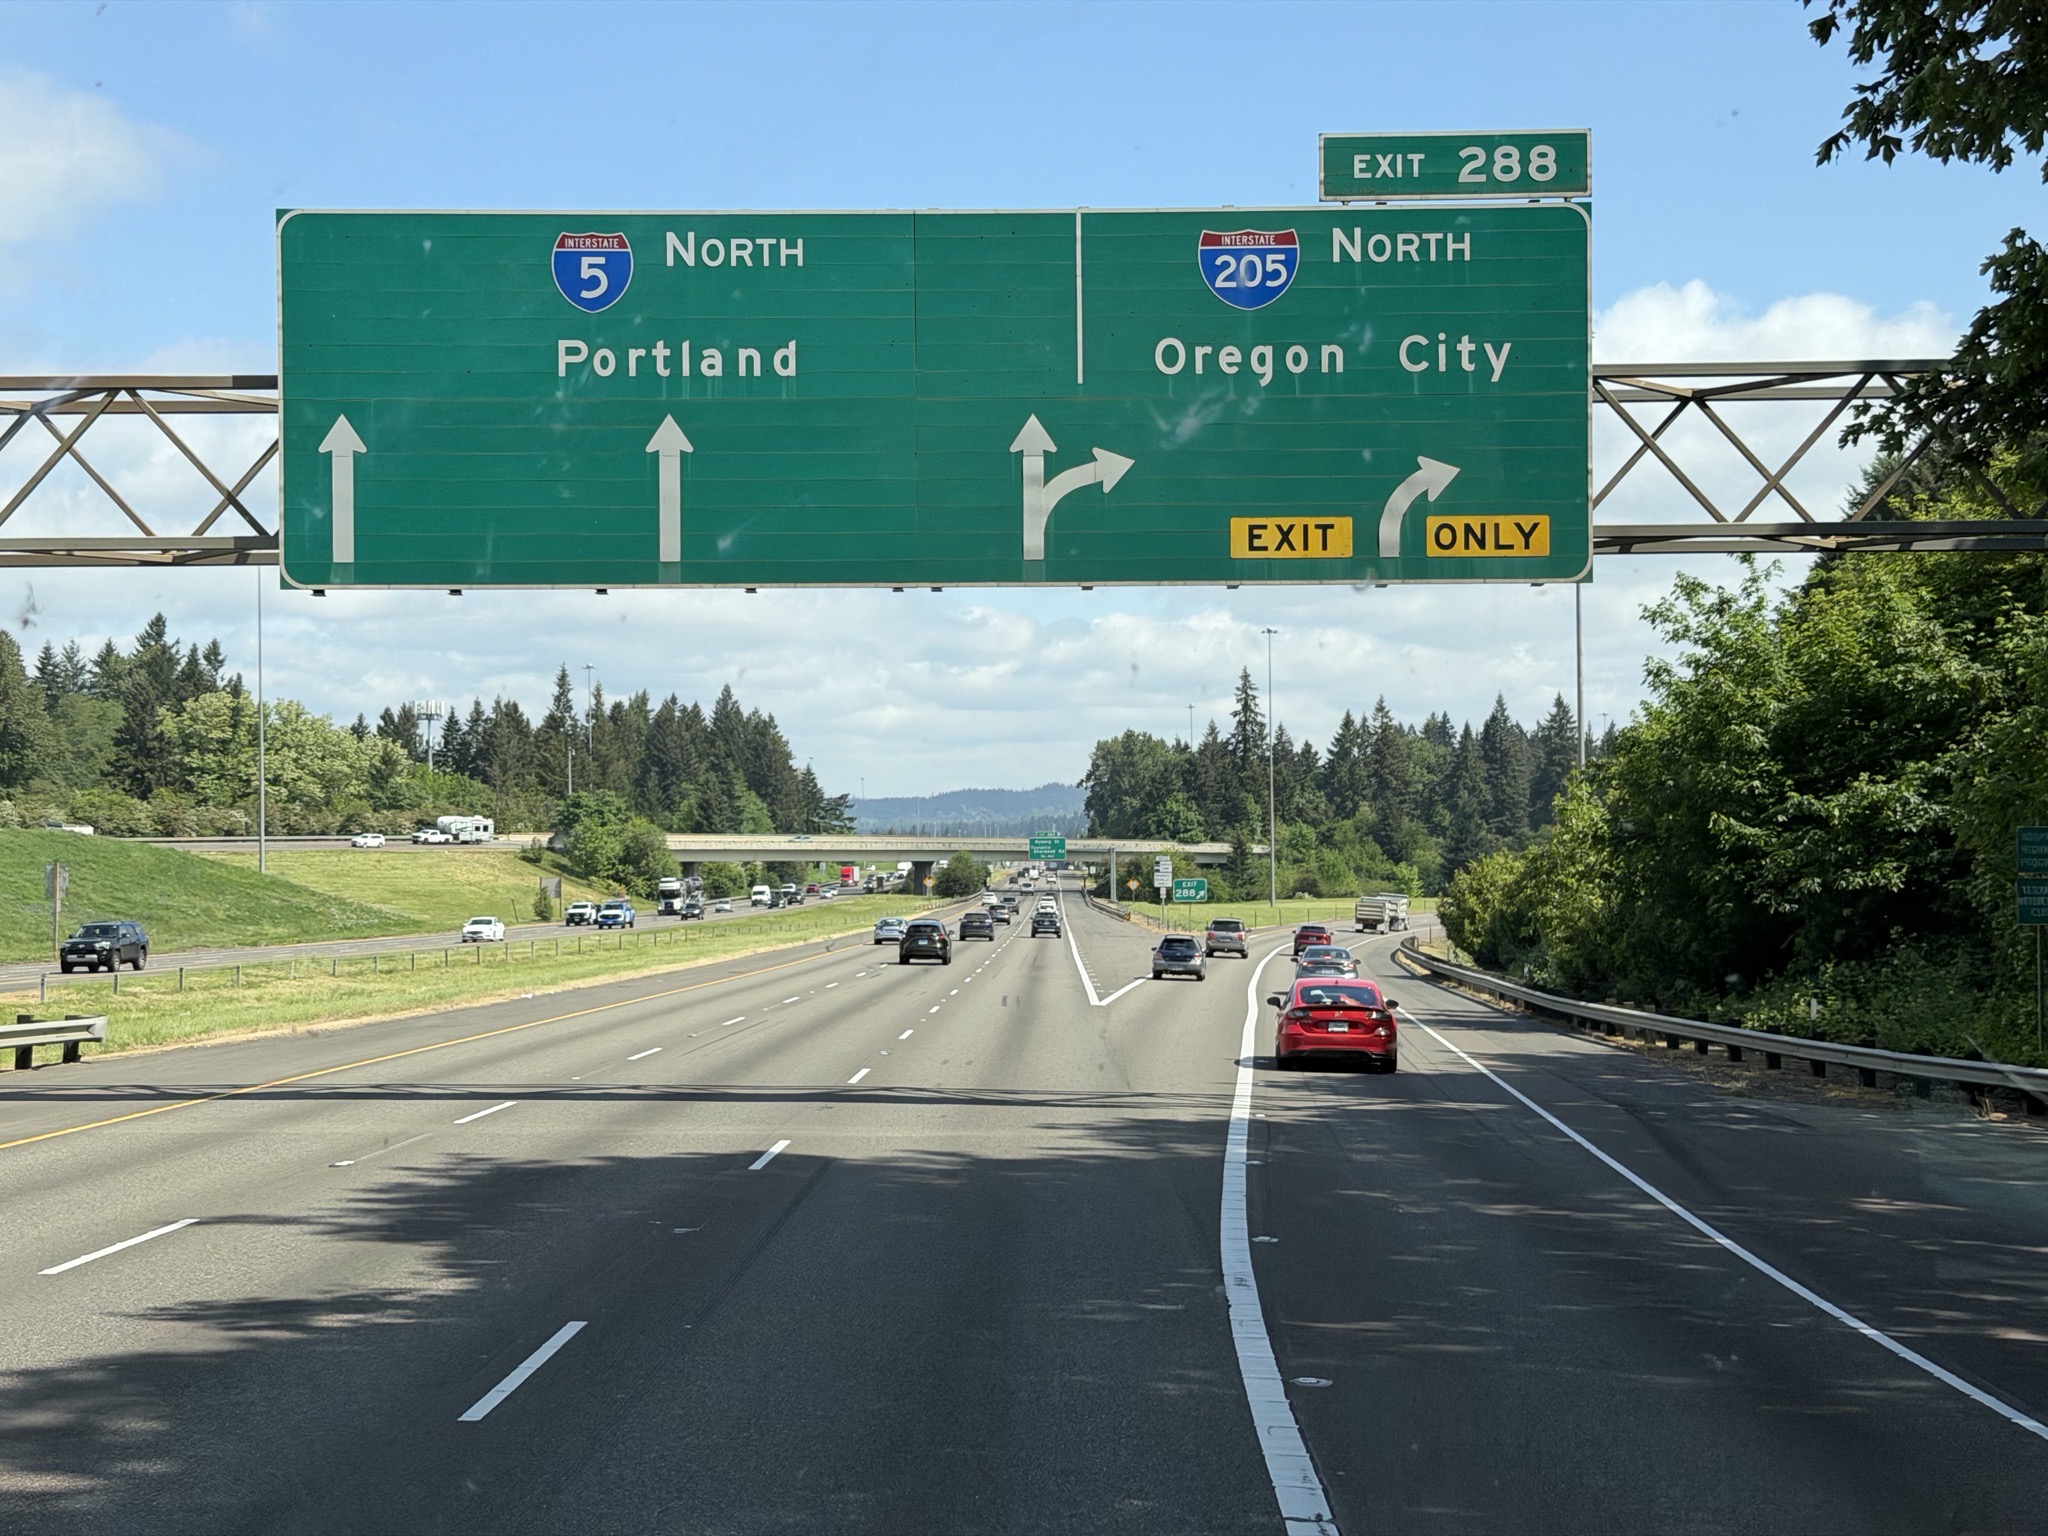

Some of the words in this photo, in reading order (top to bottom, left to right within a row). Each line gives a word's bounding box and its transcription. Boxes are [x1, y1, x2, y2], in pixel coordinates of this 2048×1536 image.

[1353, 153, 1425, 180] EXIT
[1458, 144, 1558, 183] 288
[564, 237, 620, 249] INTERSTATE
[666, 231, 804, 268] NORTH
[1221, 234, 1276, 246] INTERSTATE
[1332, 227, 1471, 263] NORTH
[579, 256, 609, 300] 5
[1214, 253, 1288, 289] 205
[558, 339, 797, 379] Portland
[1155, 337, 1344, 387] Oregon
[1399, 332, 1512, 382] City
[1248, 522, 1336, 552] EXIT
[1434, 521, 1542, 551] ONLY
[1175, 889, 1196, 898] 288
